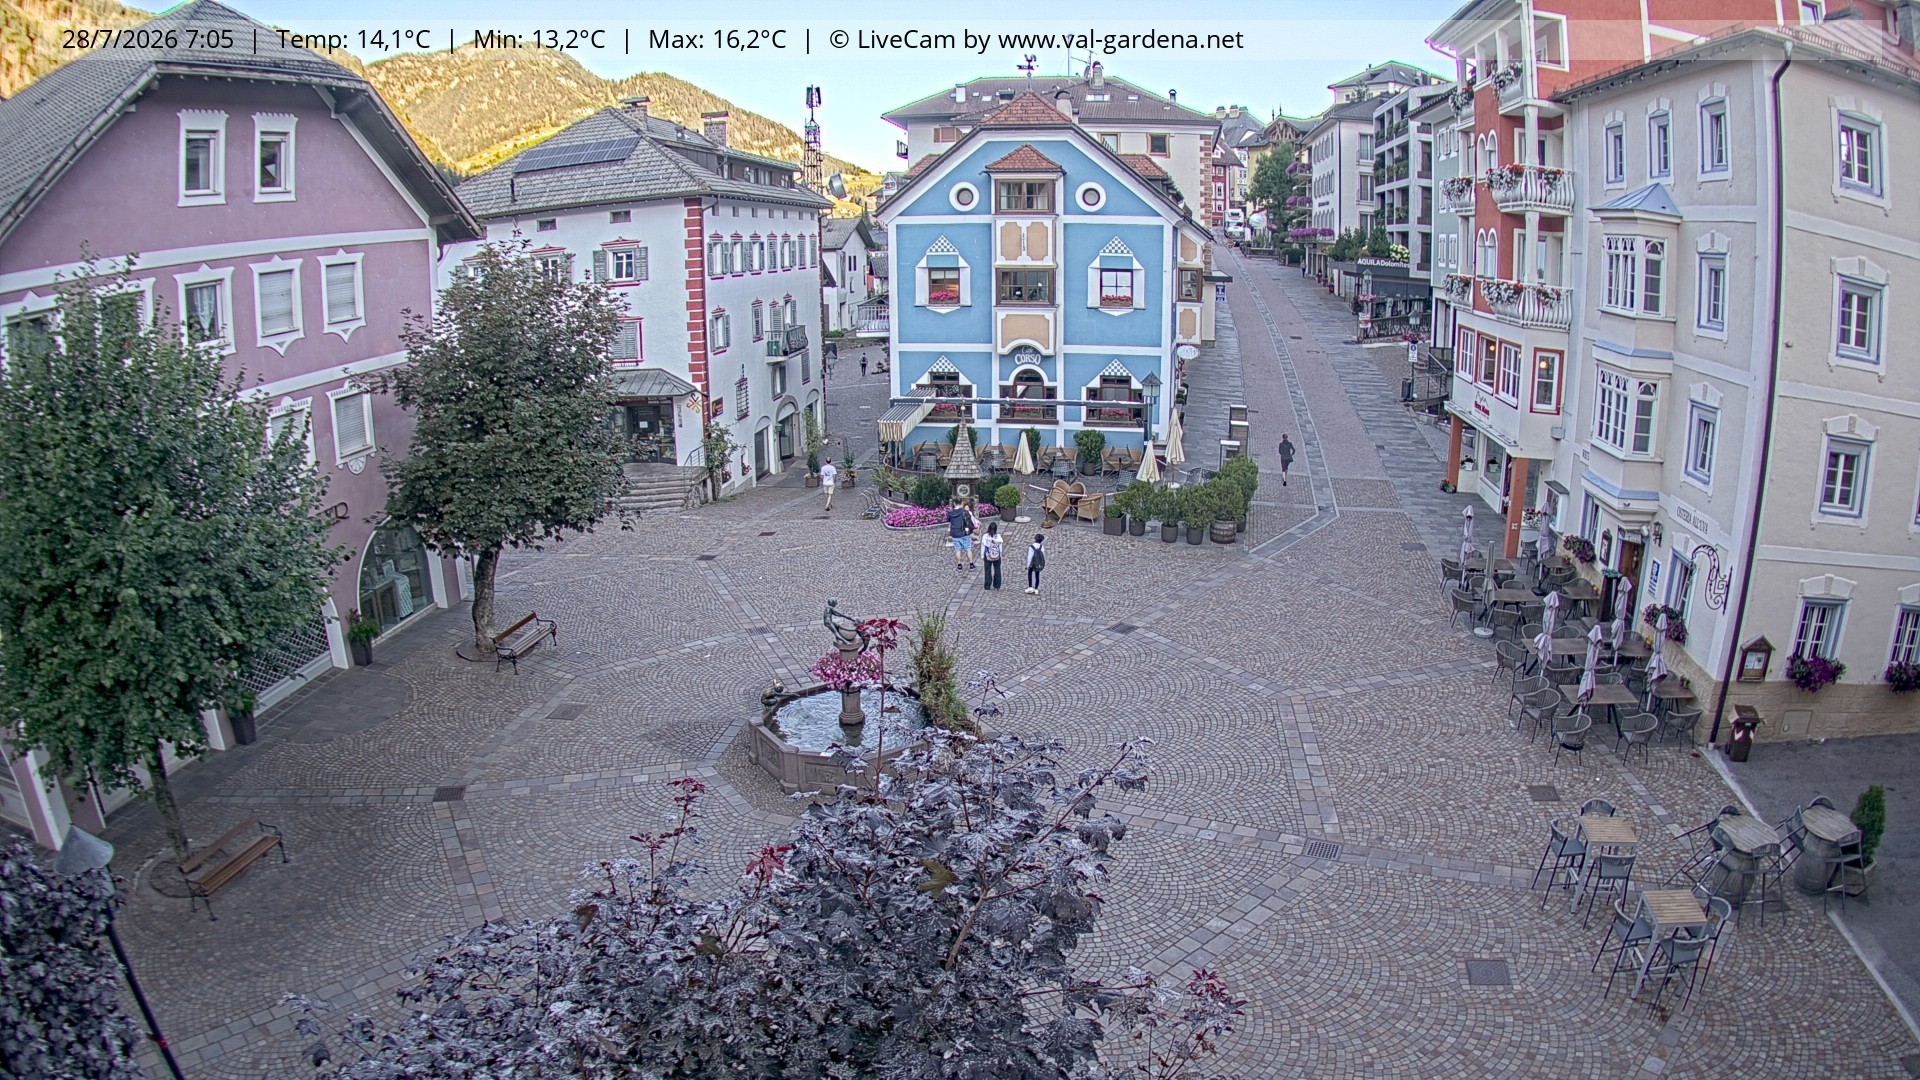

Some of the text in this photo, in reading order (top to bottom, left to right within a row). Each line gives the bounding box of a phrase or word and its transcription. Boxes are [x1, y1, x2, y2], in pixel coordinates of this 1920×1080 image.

[1357, 258, 1380, 266] AQUILA
[1014, 353, 1042, 365] CORSO
[1676, 505, 1692, 525] OSTERIA
